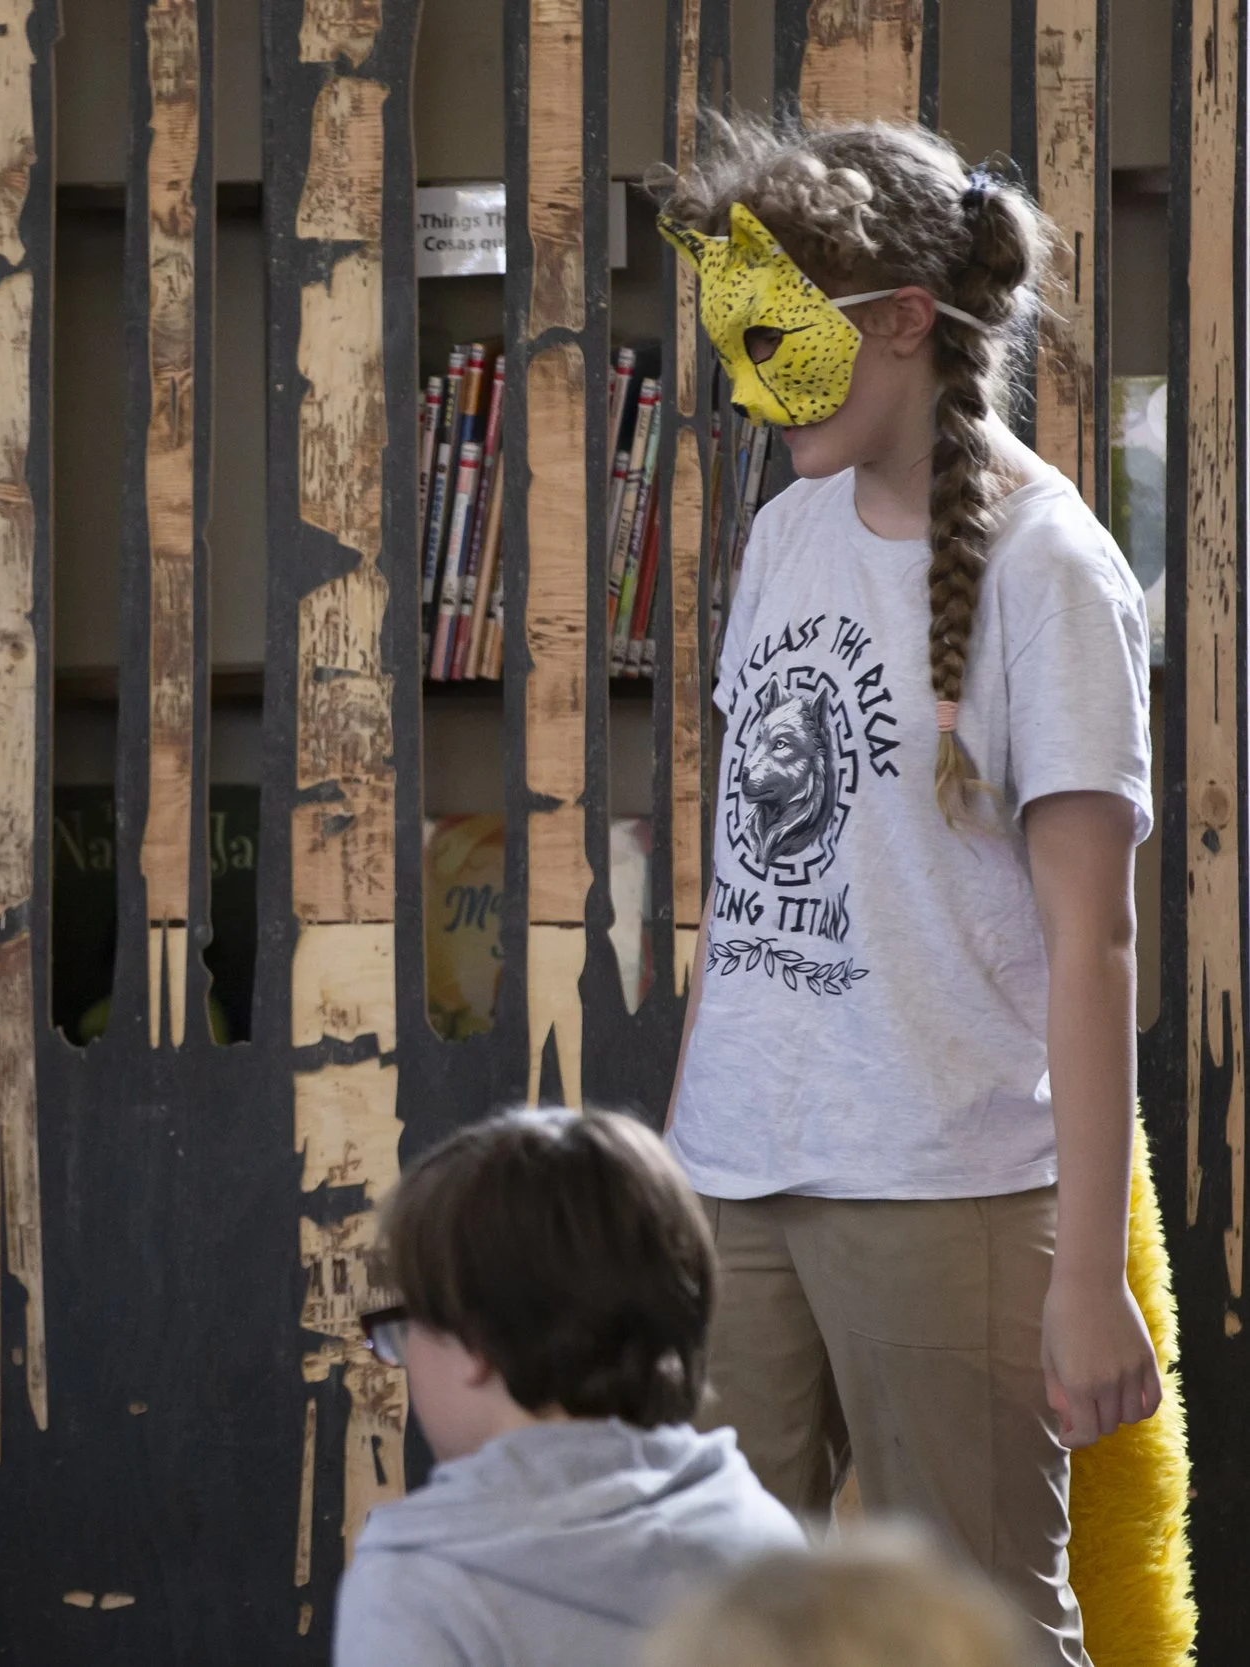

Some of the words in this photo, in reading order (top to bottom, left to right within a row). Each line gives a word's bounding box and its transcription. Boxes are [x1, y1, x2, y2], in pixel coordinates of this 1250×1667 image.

[420, 213, 480, 231] Things
[423, 236, 476, 252] Cosas
[778, 883, 850, 944] TITANS
